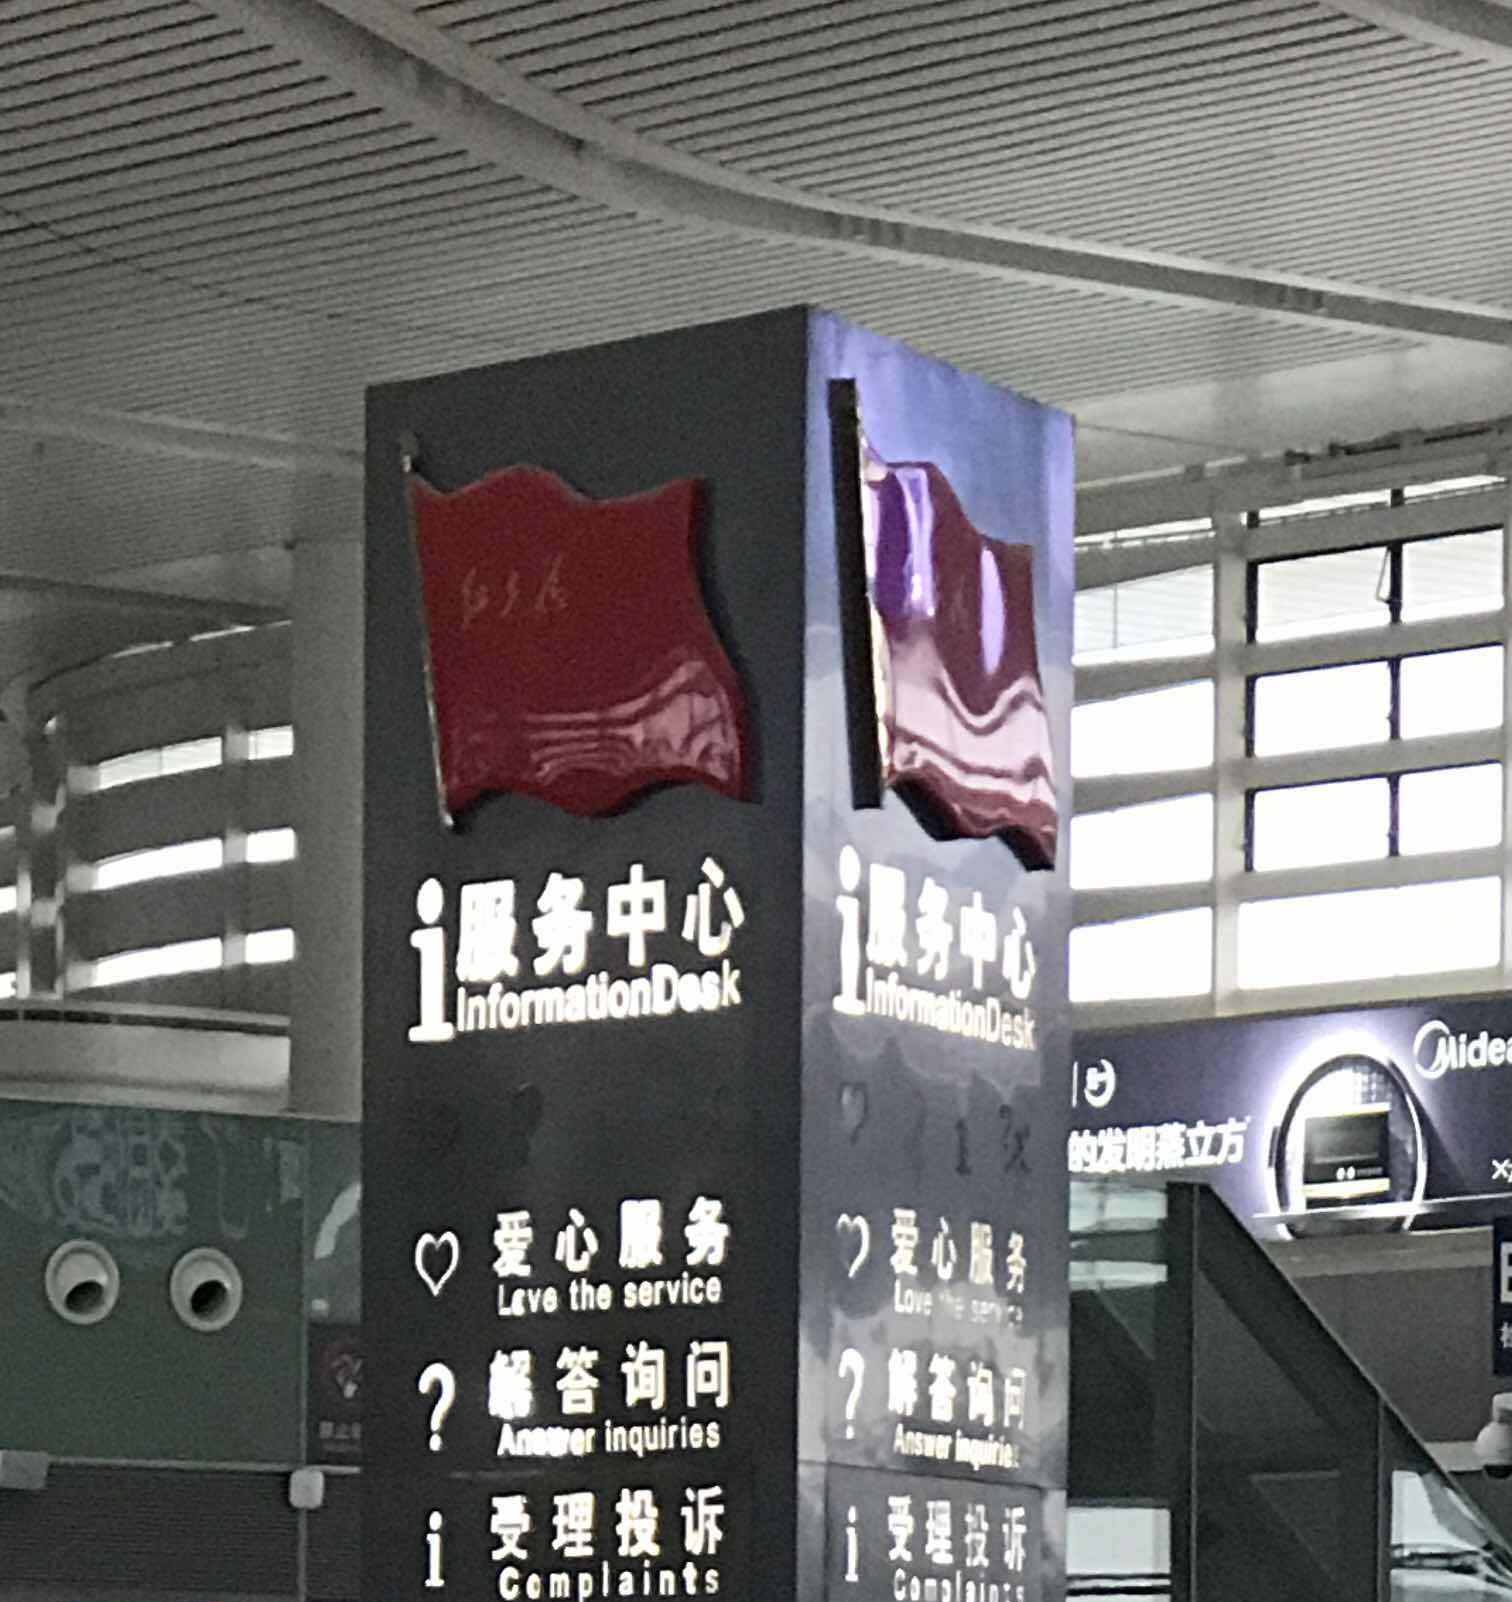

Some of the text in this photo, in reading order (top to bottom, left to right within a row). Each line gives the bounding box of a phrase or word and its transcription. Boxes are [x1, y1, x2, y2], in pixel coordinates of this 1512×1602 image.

[456, 858, 744, 982] 服务中心
[866, 864, 1036, 999] 服务中心
[493, 1197, 730, 1277] 爱心服务
[890, 1208, 1027, 1294] 爱心服务
[499, 1271, 721, 1316] Love the service
[894, 1279, 933, 1315] Love
[488, 1341, 729, 1420] 解答询问
[888, 1347, 1026, 1431] 解答询问
[605, 1415, 720, 1458] inquiries
[490, 1487, 725, 1563] 受理投诉
[888, 1495, 1027, 1572] 受理投诉
